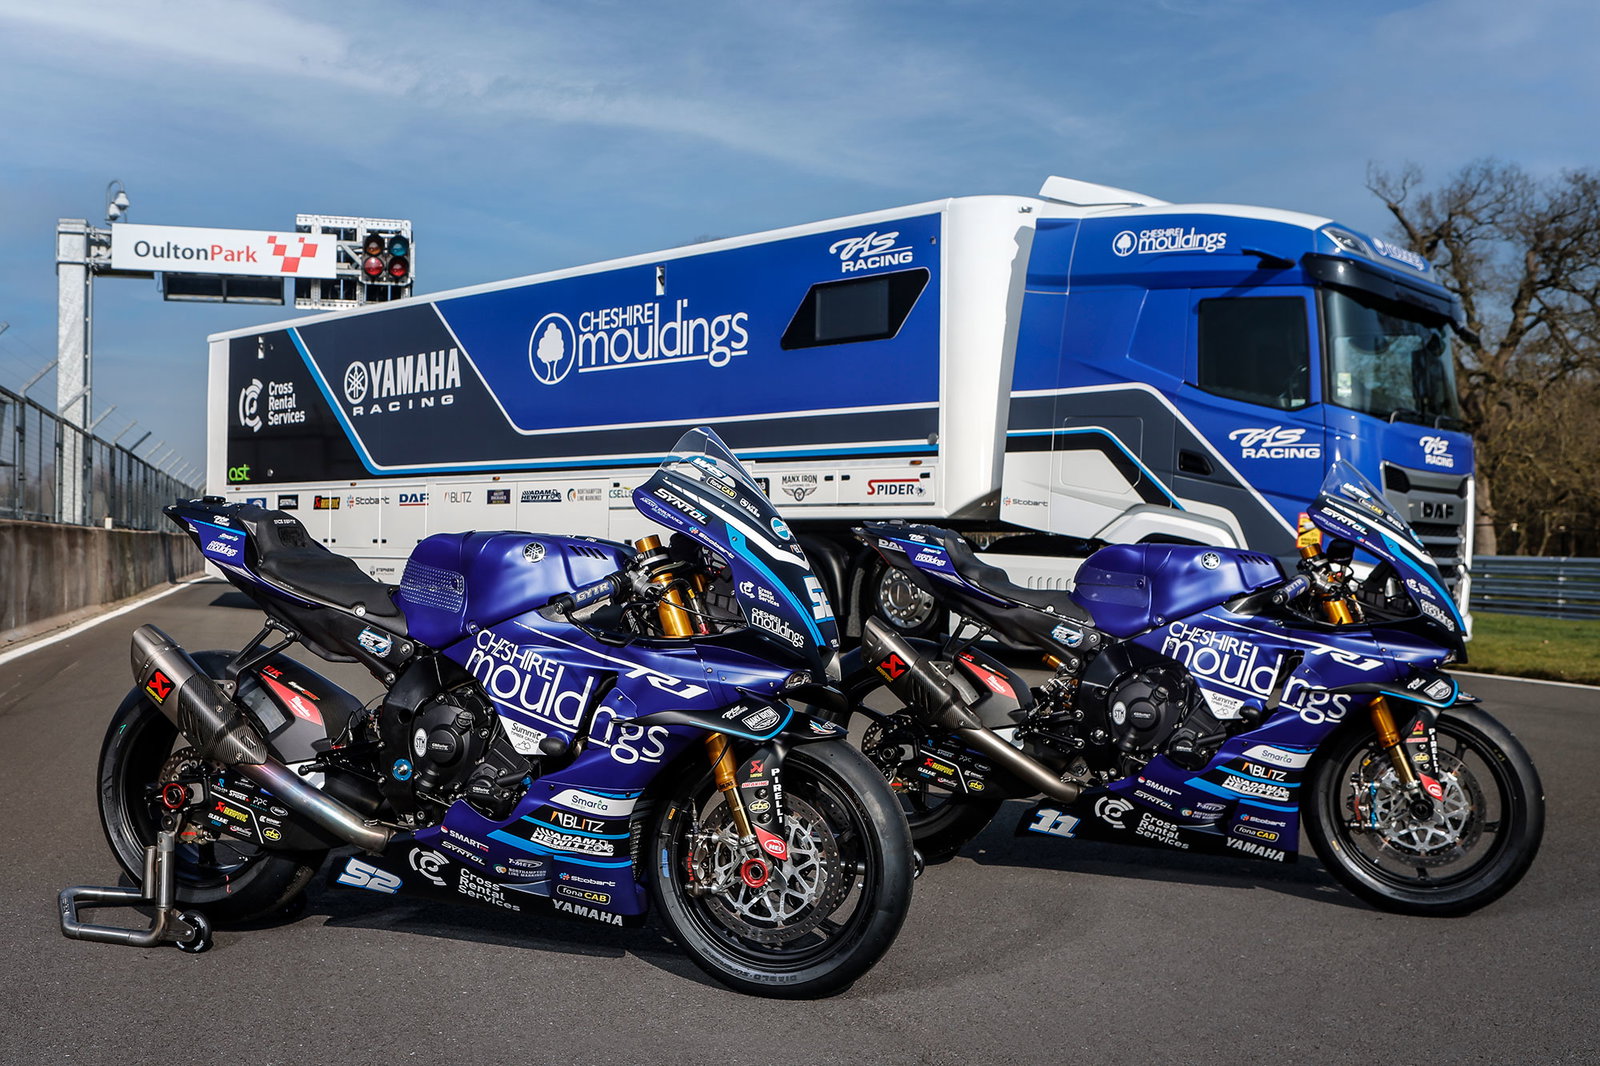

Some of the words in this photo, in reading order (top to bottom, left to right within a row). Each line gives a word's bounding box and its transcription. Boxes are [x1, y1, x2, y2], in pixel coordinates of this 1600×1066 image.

[1138, 227, 1228, 253] mouldings
[1140, 228, 1180, 239] CHESHIRE
[134, 241, 257, 263] OultonPark
[841, 252, 913, 273] RACING
[579, 302, 653, 333] CHESHIRE
[578, 299, 749, 368] mouldings
[369, 348, 461, 399] YAMAHA
[268, 381, 293, 395] Cross
[268, 394, 296, 410] Rental
[352, 394, 454, 416] RACING
[268, 409, 305, 426] Services
[1242, 447, 1321, 459] RACING
[1425, 454, 1454, 468] RACING
[782, 475, 800, 485] MANX
[801, 475, 817, 484] IRON
[867, 479, 919, 496] SPIDER
[399, 493, 430, 504] DAF
[721, 486, 735, 497] CAB
[653, 488, 707, 525] SYNTOL
[1012, 498, 1048, 507] Stobart
[1420, 501, 1453, 519] DAF
[1320, 506, 1368, 535] SYNTOL
[576, 582, 610, 603] GYTR
[751, 608, 779, 623] CHESHIRE
[751, 613, 805, 649] mouldings
[1168, 621, 1249, 659] CHESHIRE
[476, 629, 558, 681] CHESHIRE
[1161, 636, 1352, 725] mouldngs
[465, 648, 669, 765] mouldngs
[1211, 693, 1238, 706] Summit
[511, 722, 542, 741] Summit
[524, 735, 539, 744] GROUP
[1261, 749, 1293, 764] Smarta
[1428, 728, 1439, 774] PIRELLI
[771, 768, 784, 824] PIRELLI
[1145, 779, 1181, 796] SMART
[571, 794, 609, 811] Smarta
[1133, 789, 1173, 810] SYNTOL
[1029, 808, 1080, 838] 11
[1138, 819, 1179, 840] Rental
[1142, 812, 1178, 832] Cross
[449, 829, 488, 850] SMART
[530, 832, 590, 851] HEWITT
[551, 832, 597, 845] ADAM
[1135, 826, 1190, 850] Services
[1238, 826, 1257, 836] fona
[1256, 831, 1276, 840] CAB
[441, 840, 486, 866] SYNTOL
[1226, 837, 1286, 862] YAMAHA
[338, 857, 403, 894] 52
[460, 868, 500, 891] Cross
[570, 875, 616, 887] Stobart
[458, 885, 521, 912] Services
[459, 877, 506, 901] Rental
[562, 887, 583, 898] fona
[584, 892, 607, 902] CAB
[552, 899, 623, 927] YAMAHA
